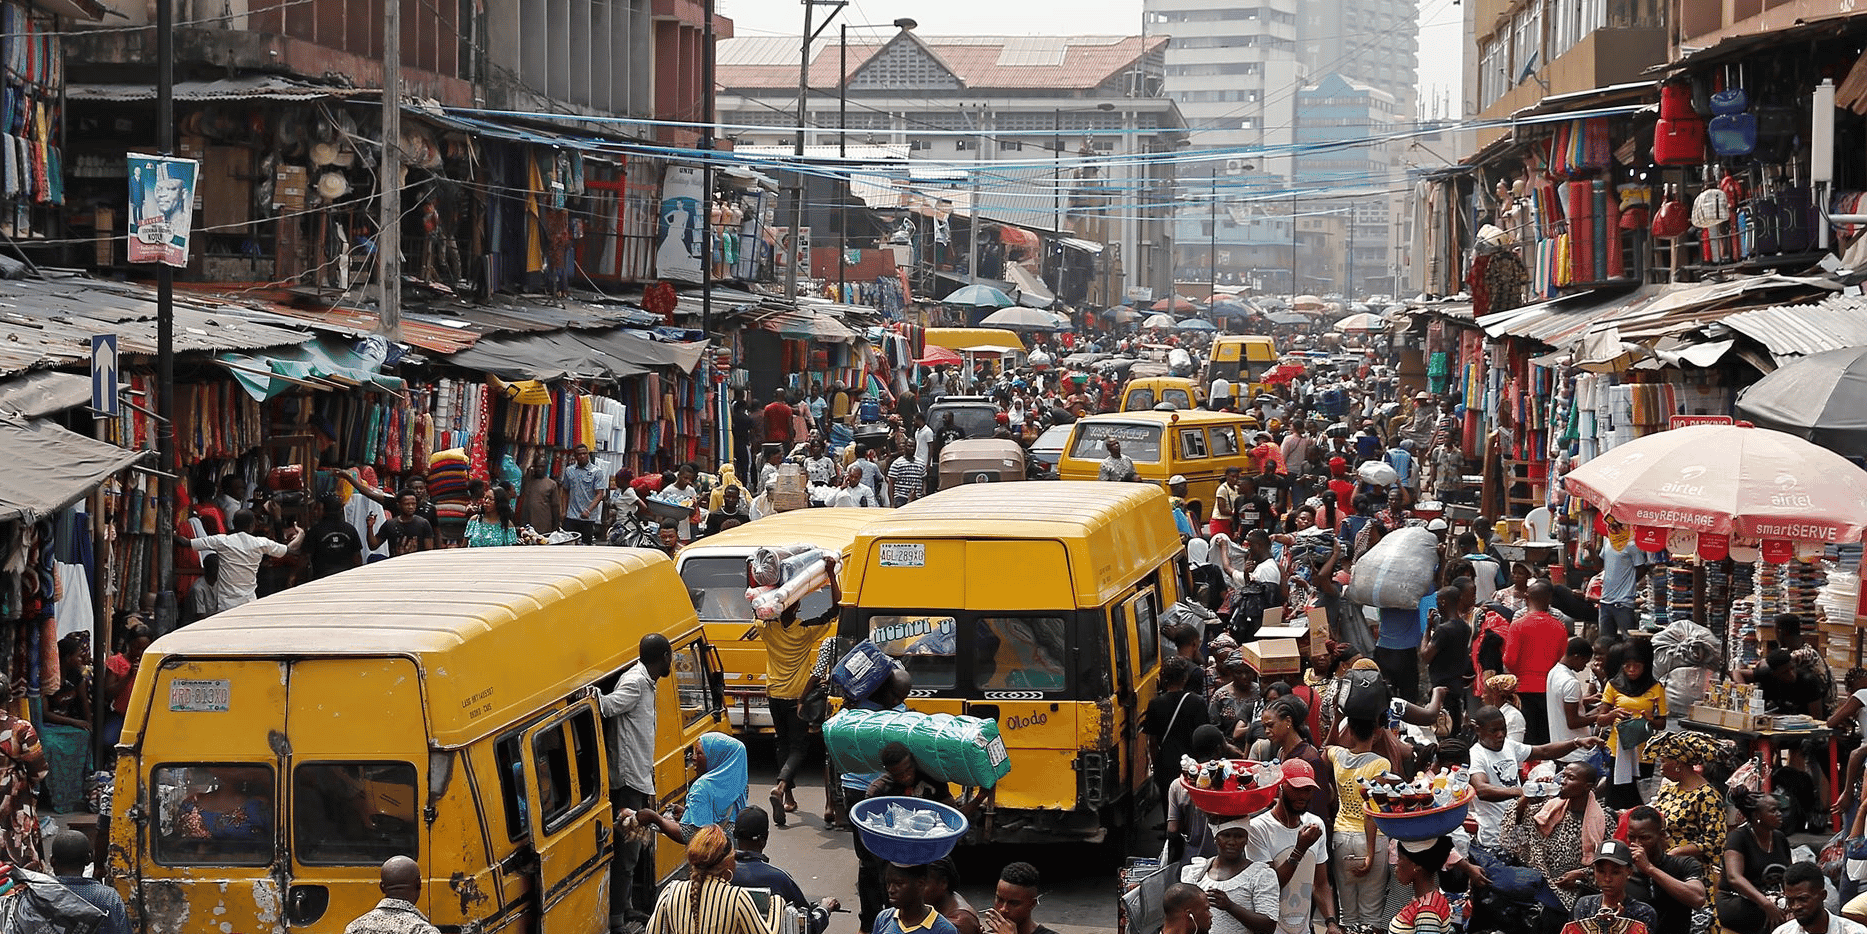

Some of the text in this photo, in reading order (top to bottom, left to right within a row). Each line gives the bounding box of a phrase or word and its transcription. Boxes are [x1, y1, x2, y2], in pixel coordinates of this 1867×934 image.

[1662, 481, 1705, 496] airtel
[1771, 493, 1815, 507] airtel
[1636, 509, 1715, 527] easyRECHARGE
[1756, 524, 1837, 540] smartSERVE
[1006, 710, 1047, 729] Olodo
